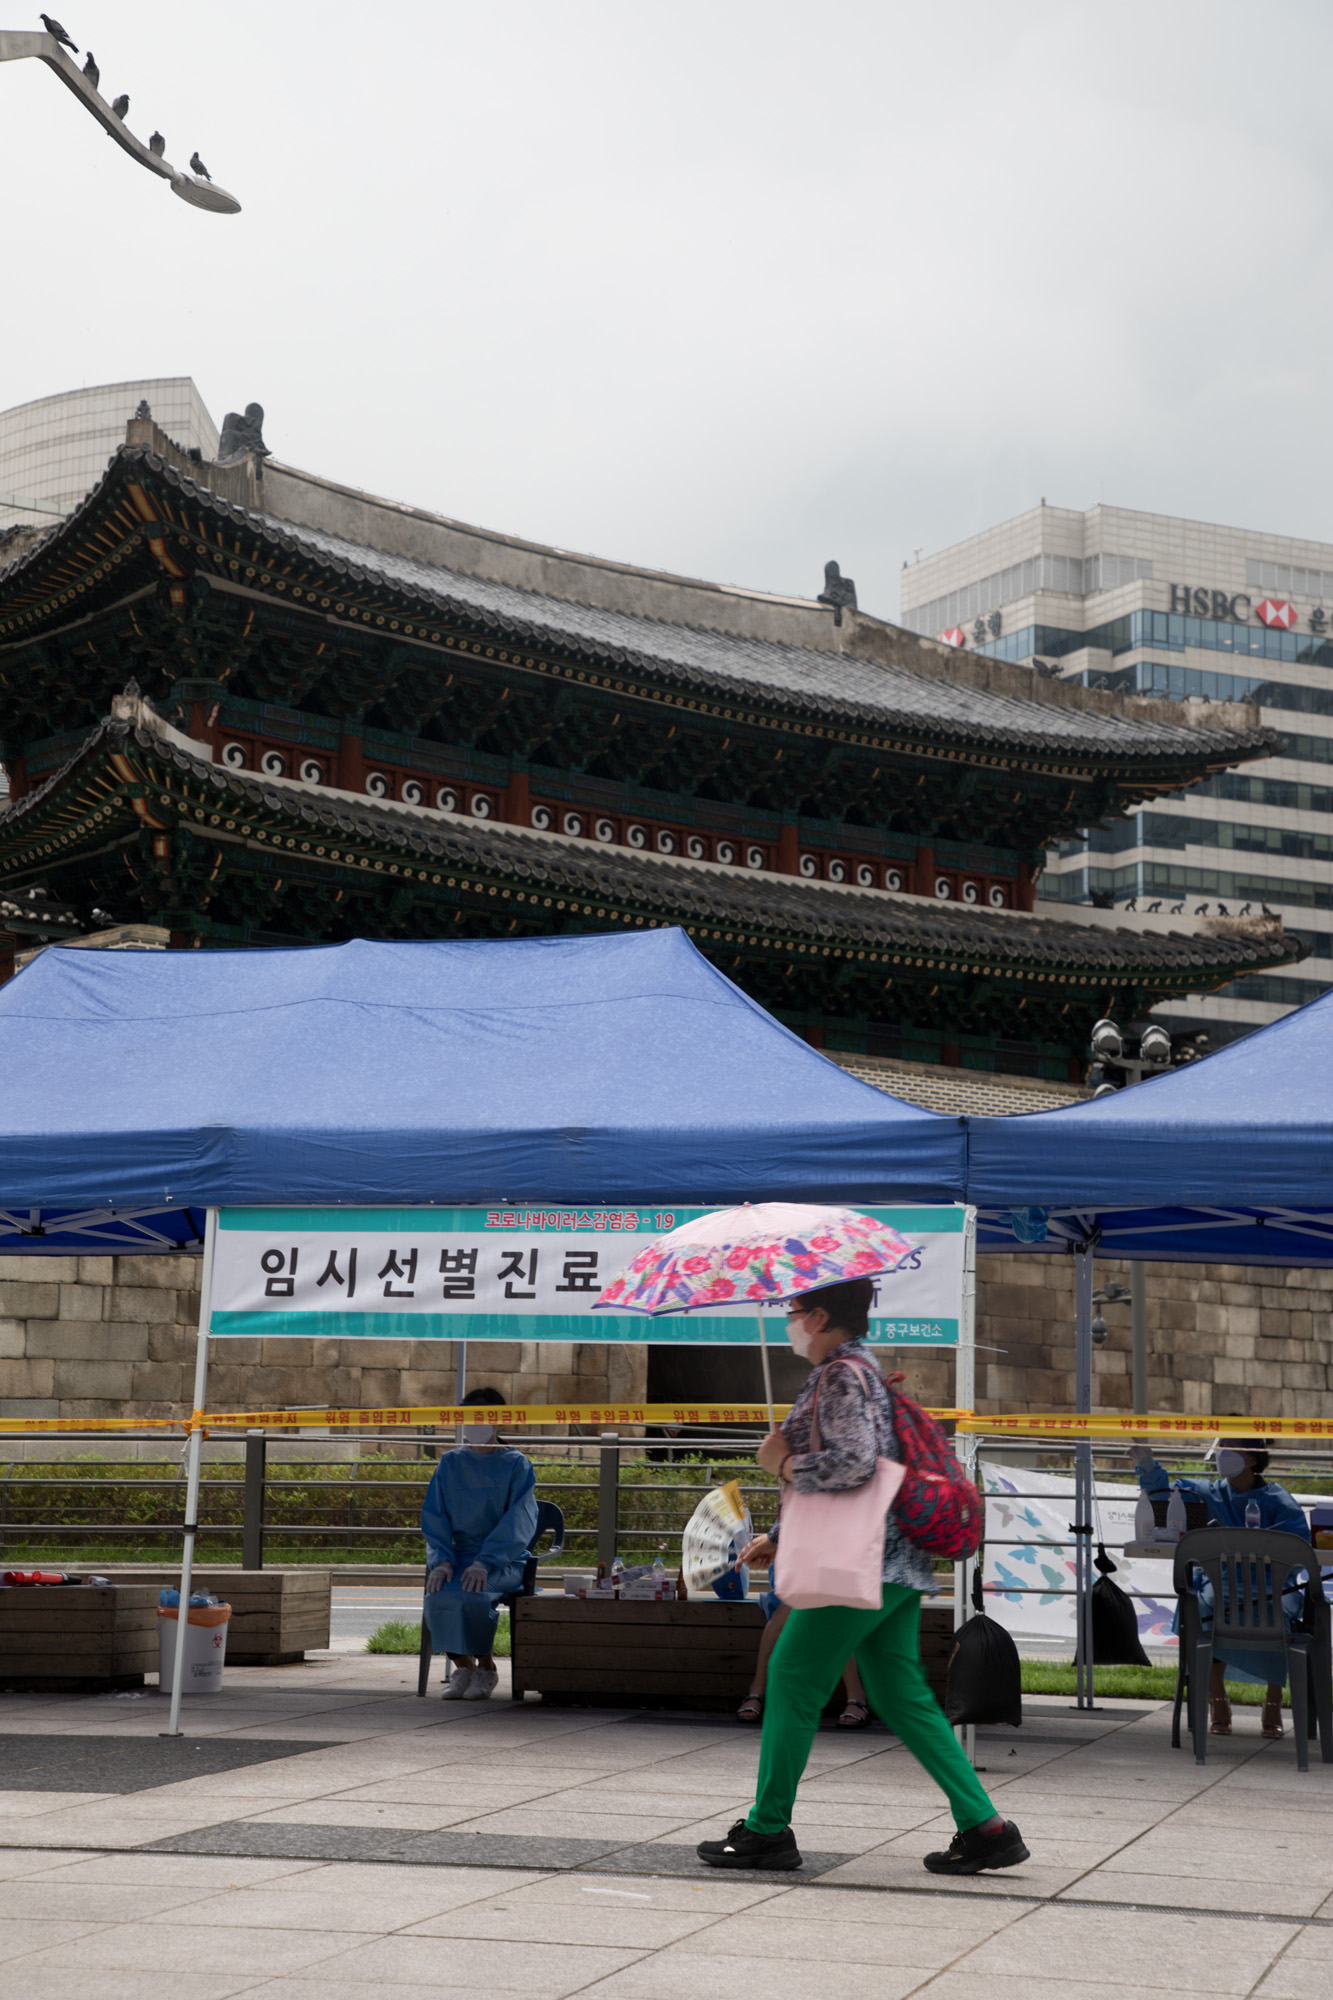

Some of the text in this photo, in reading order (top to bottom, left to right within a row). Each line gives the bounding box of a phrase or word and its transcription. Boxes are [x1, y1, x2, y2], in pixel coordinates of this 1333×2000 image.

[1170, 583, 1251, 622] HSBC
[485, 1211, 639, 1230] 코로나바이러스감염증
[655, 1212, 675, 1229] 19
[885, 1323, 943, 1339] 중구보건소
[325, 1411, 350, 1424] 위험
[439, 1410, 527, 1425] 위험 출입금지
[555, 1409, 644, 1425] 위험 출입금지
[673, 1409, 764, 1422] 위험 출입금지
